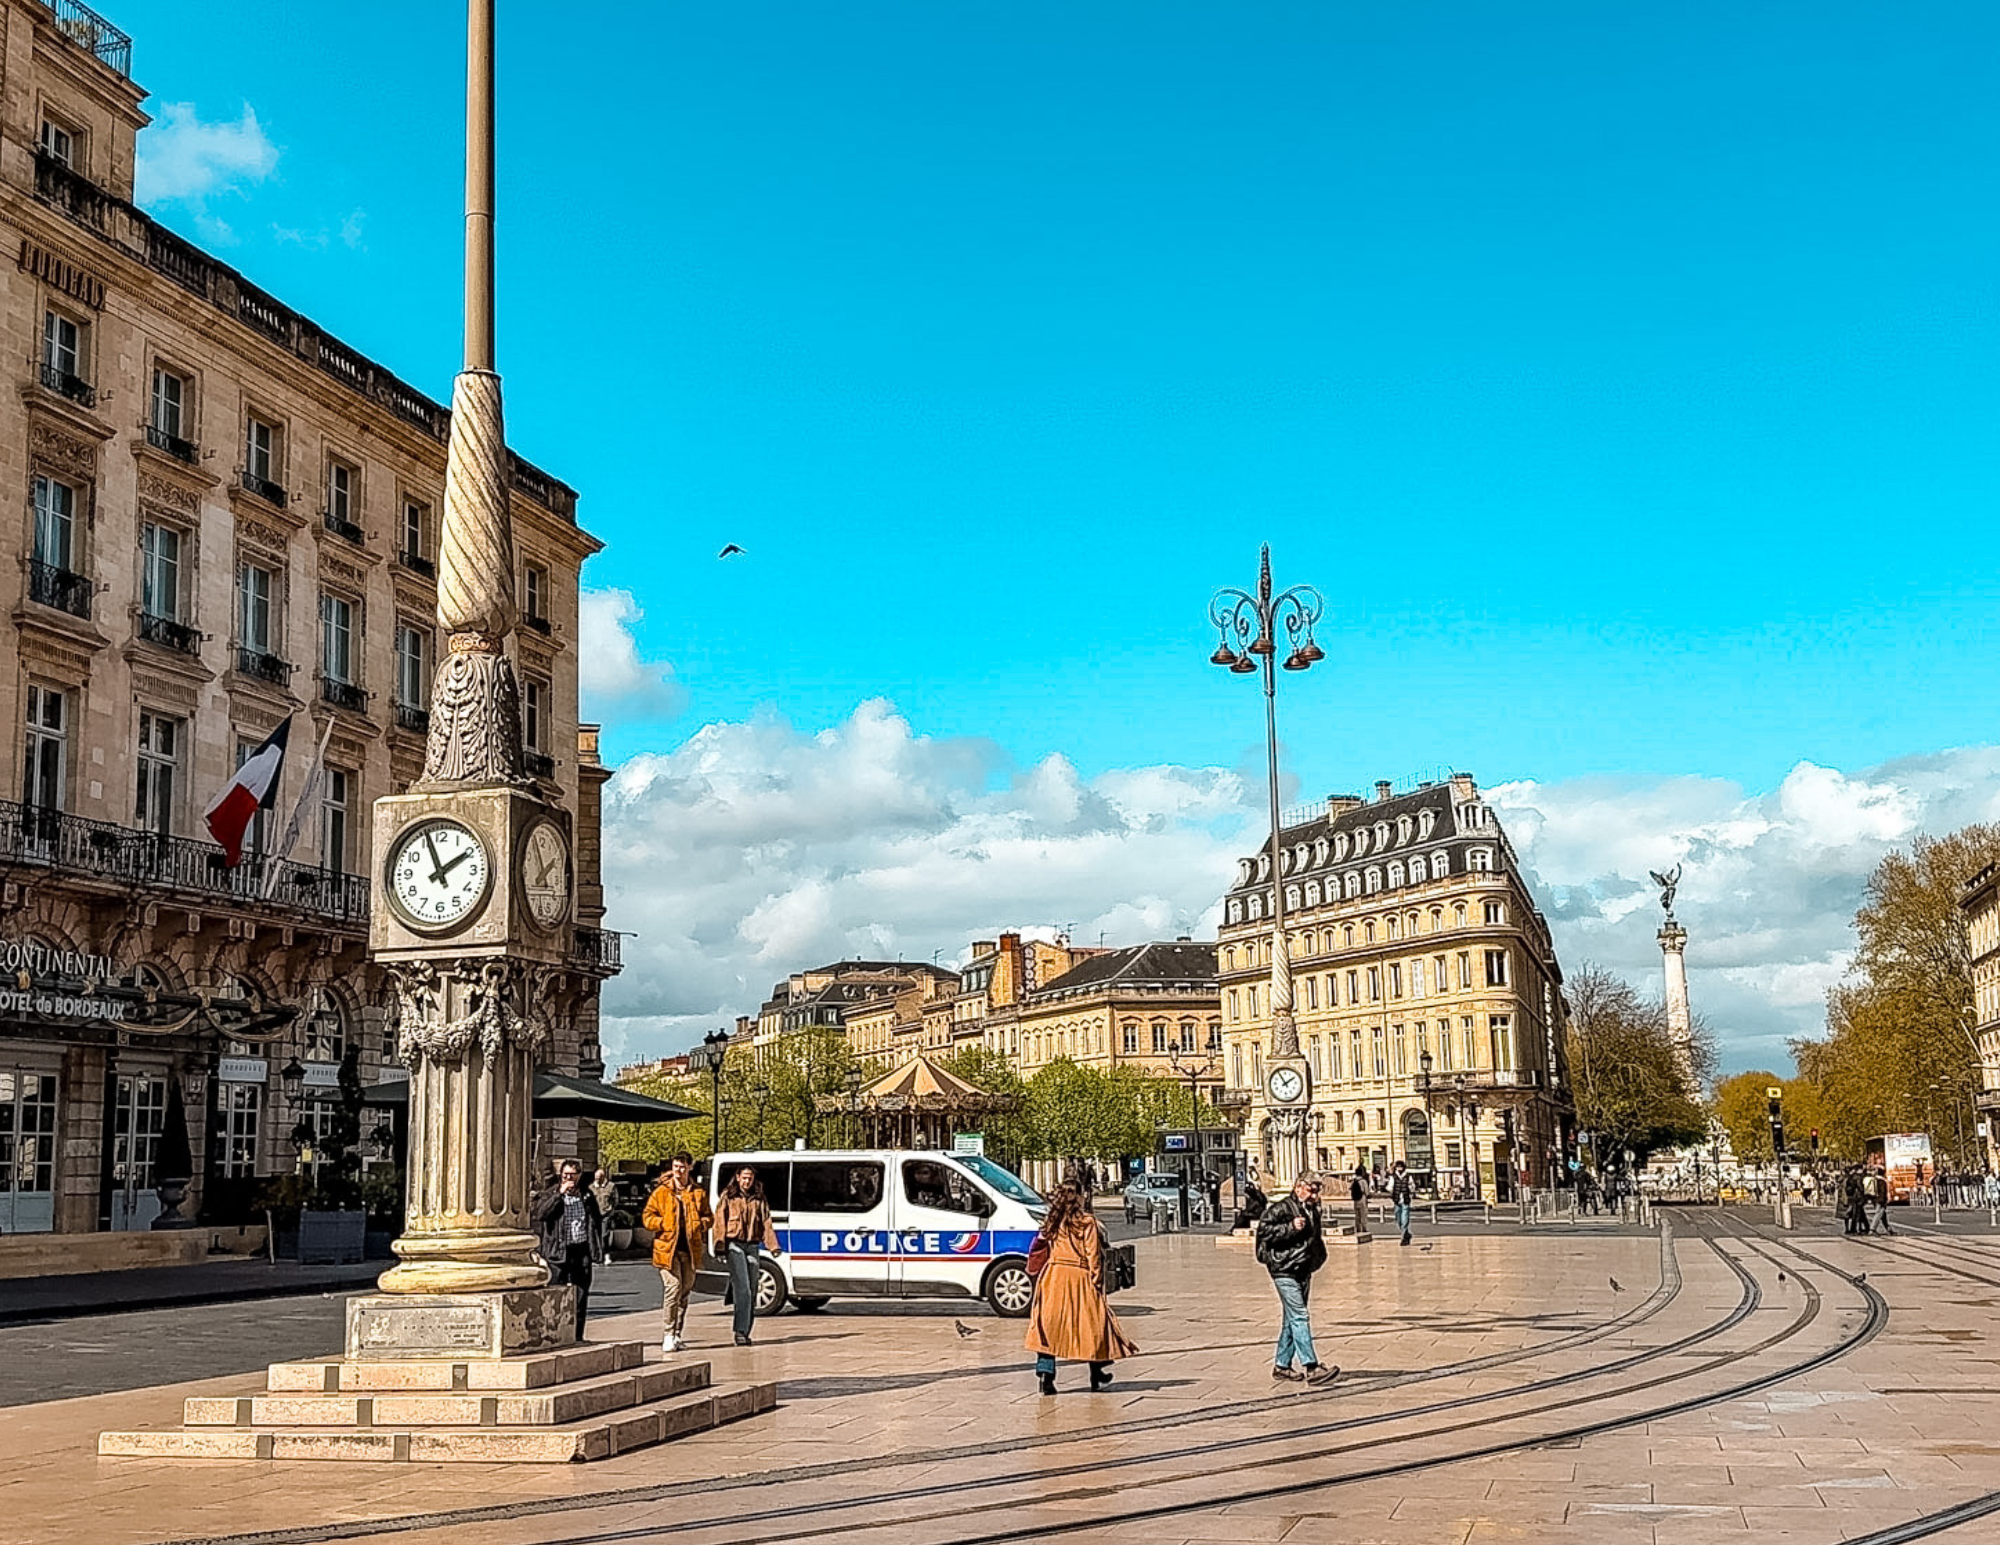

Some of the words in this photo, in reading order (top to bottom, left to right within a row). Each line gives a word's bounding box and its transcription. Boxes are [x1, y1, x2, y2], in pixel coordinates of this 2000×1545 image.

[435, 831, 448, 843] 12
[408, 851, 420, 863] 10
[403, 868, 413, 880] 9
[469, 864, 478, 876] 3
[408, 885, 418, 897] 8
[462, 881, 473, 892] 4
[419, 897, 429, 909] 7
[435, 901, 445, 913] 6
[452, 896, 461, 907] 5
[36, 996, 53, 1013] de
[55, 997, 125, 1020] BORDEAUX
[820, 1232, 940, 1252] POLICE
